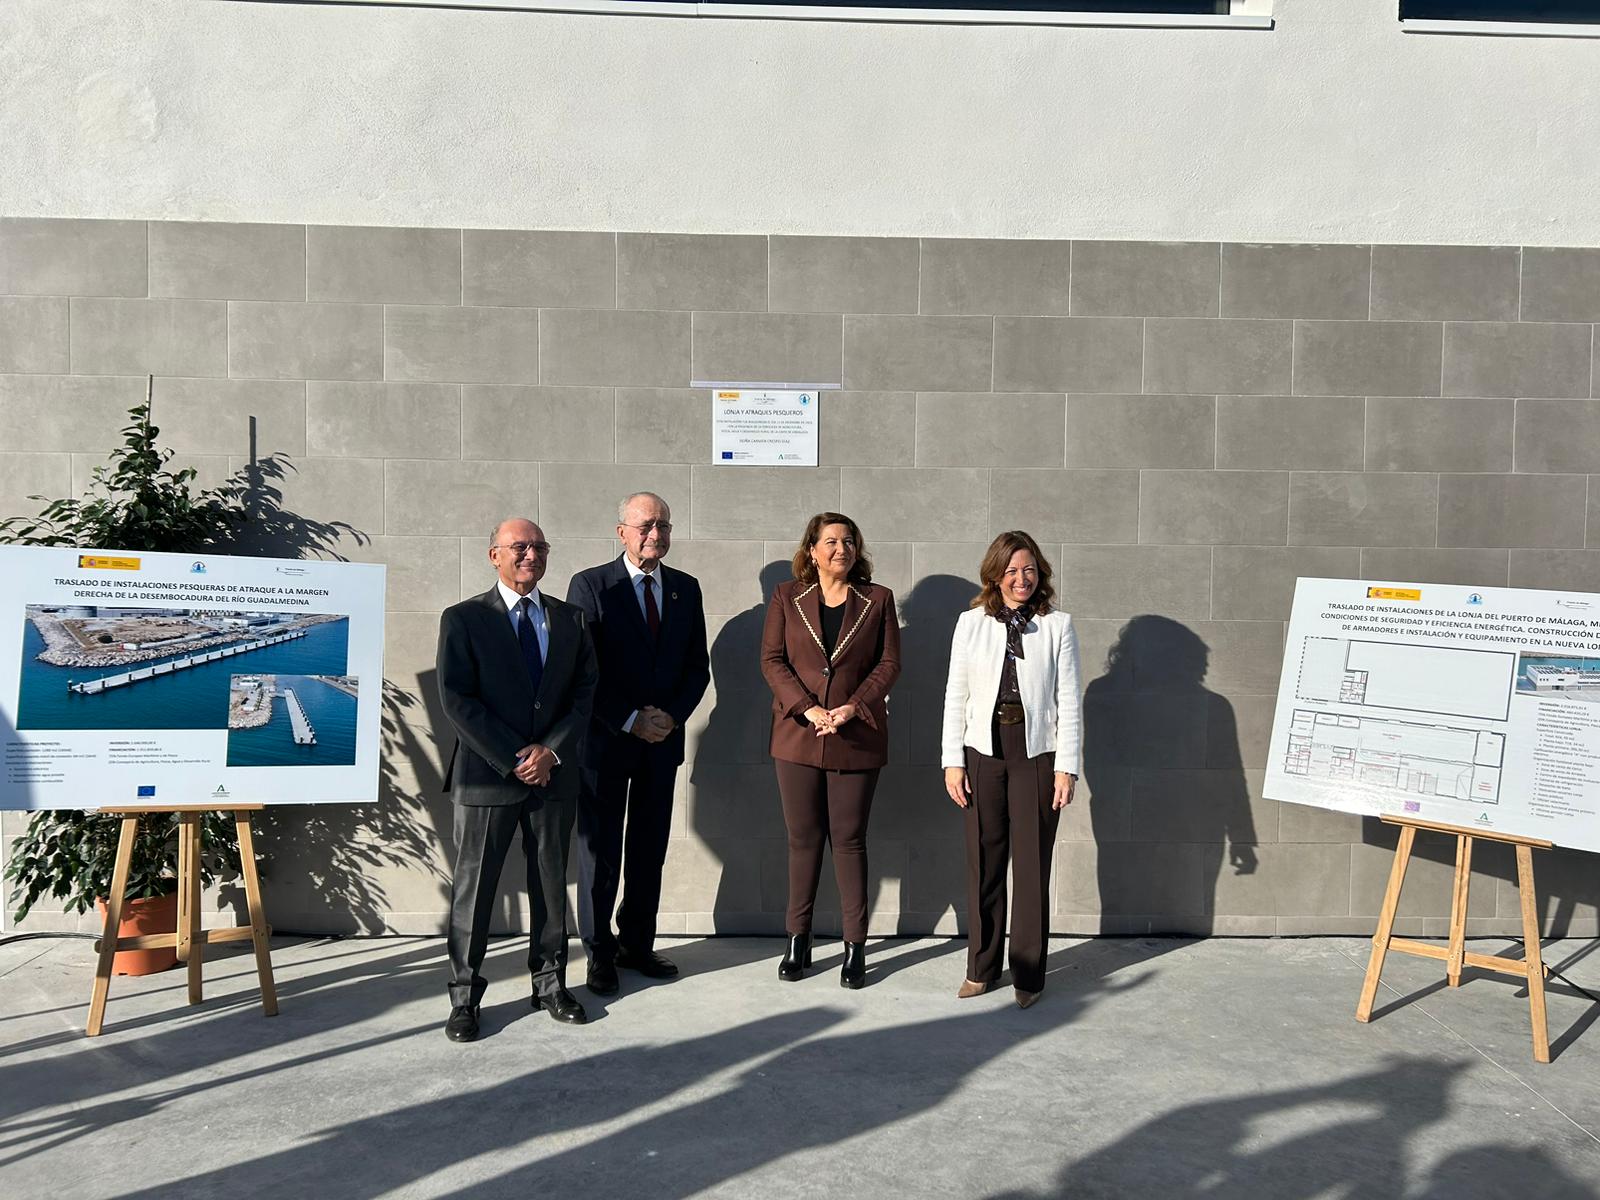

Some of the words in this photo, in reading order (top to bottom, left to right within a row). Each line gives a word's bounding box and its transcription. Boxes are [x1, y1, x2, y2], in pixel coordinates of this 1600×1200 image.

[54, 578, 98, 587] TRASLADO
[114, 581, 177, 590] INSTALACIONES
[179, 583, 225, 592] PESQUERAS
[239, 586, 276, 594] ATRAQUE
[296, 588, 329, 596] MARGEN
[74, 590, 113, 598] DERECHA
[140, 593, 213, 602] DESEMBOCADURA
[231, 595, 245, 603] RÍO
[247, 597, 310, 606] GUADALMEDINA
[1321, 612, 1368, 621] CONDICIONES
[1380, 617, 1423, 626] SEGURIDAD
[1431, 620, 1472, 629] EFICIENCIA
[1474, 623, 1525, 633] ENERGÉTICA.
[1528, 627, 1593, 638] CONSTRUCCIÓN
[1328, 603, 1364, 611] TRASLADO
[1377, 606, 1433, 615] INSTALACIONES
[1458, 611, 1482, 619] LONJA
[1501, 615, 1533, 623] PUERTO
[1548, 616, 1588, 627] MÁLAGA,
[1353, 625, 1398, 634] ARMADORES
[1406, 629, 1456, 639] INSTALACIÓN
[1465, 634, 1527, 644] EQUIPAMIENTO
[1555, 641, 1584, 649] NUEVA
